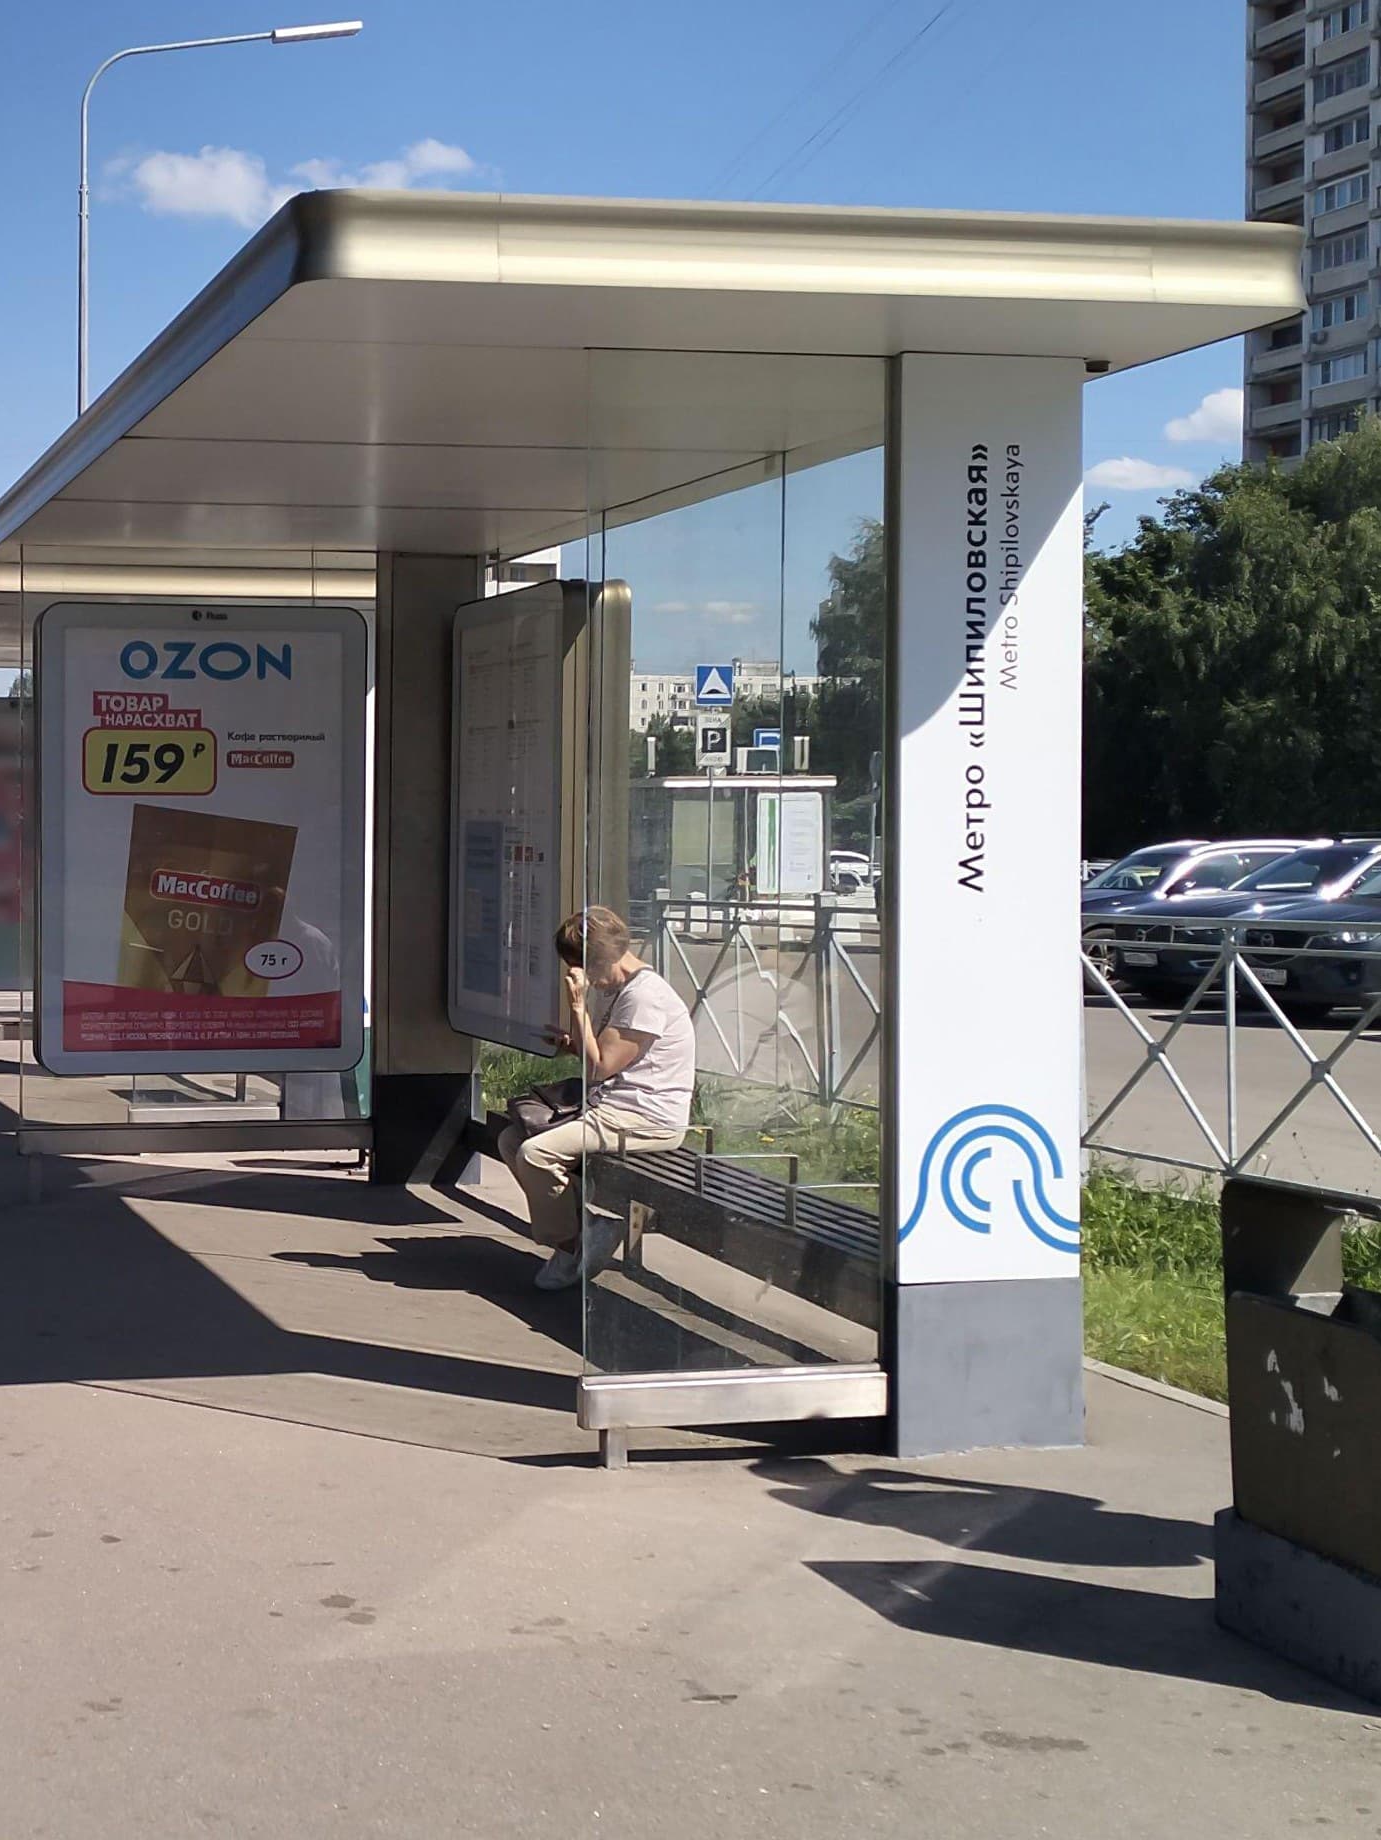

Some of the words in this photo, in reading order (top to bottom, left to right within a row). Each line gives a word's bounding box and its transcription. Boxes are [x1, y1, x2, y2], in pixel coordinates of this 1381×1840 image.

[999, 443, 1024, 607] Shipilovskaya
[958, 443, 989, 748] «Шипиловская»
[120, 641, 291, 680] OZON
[999, 614, 1018, 690] Metro
[98, 695, 163, 712] ТОВАР
[105, 713, 198, 728] НАРАСХВАТ
[227, 732, 256, 744] Кофе
[258, 732, 326, 744] растворимый
[101, 743, 185, 784] 159
[230, 752, 293, 766] MacCoffee
[958, 763, 991, 893] Метро
[156, 874, 258, 906] MacCoffee
[167, 909, 234, 936] GOLD
[261, 953, 276, 966] 75
